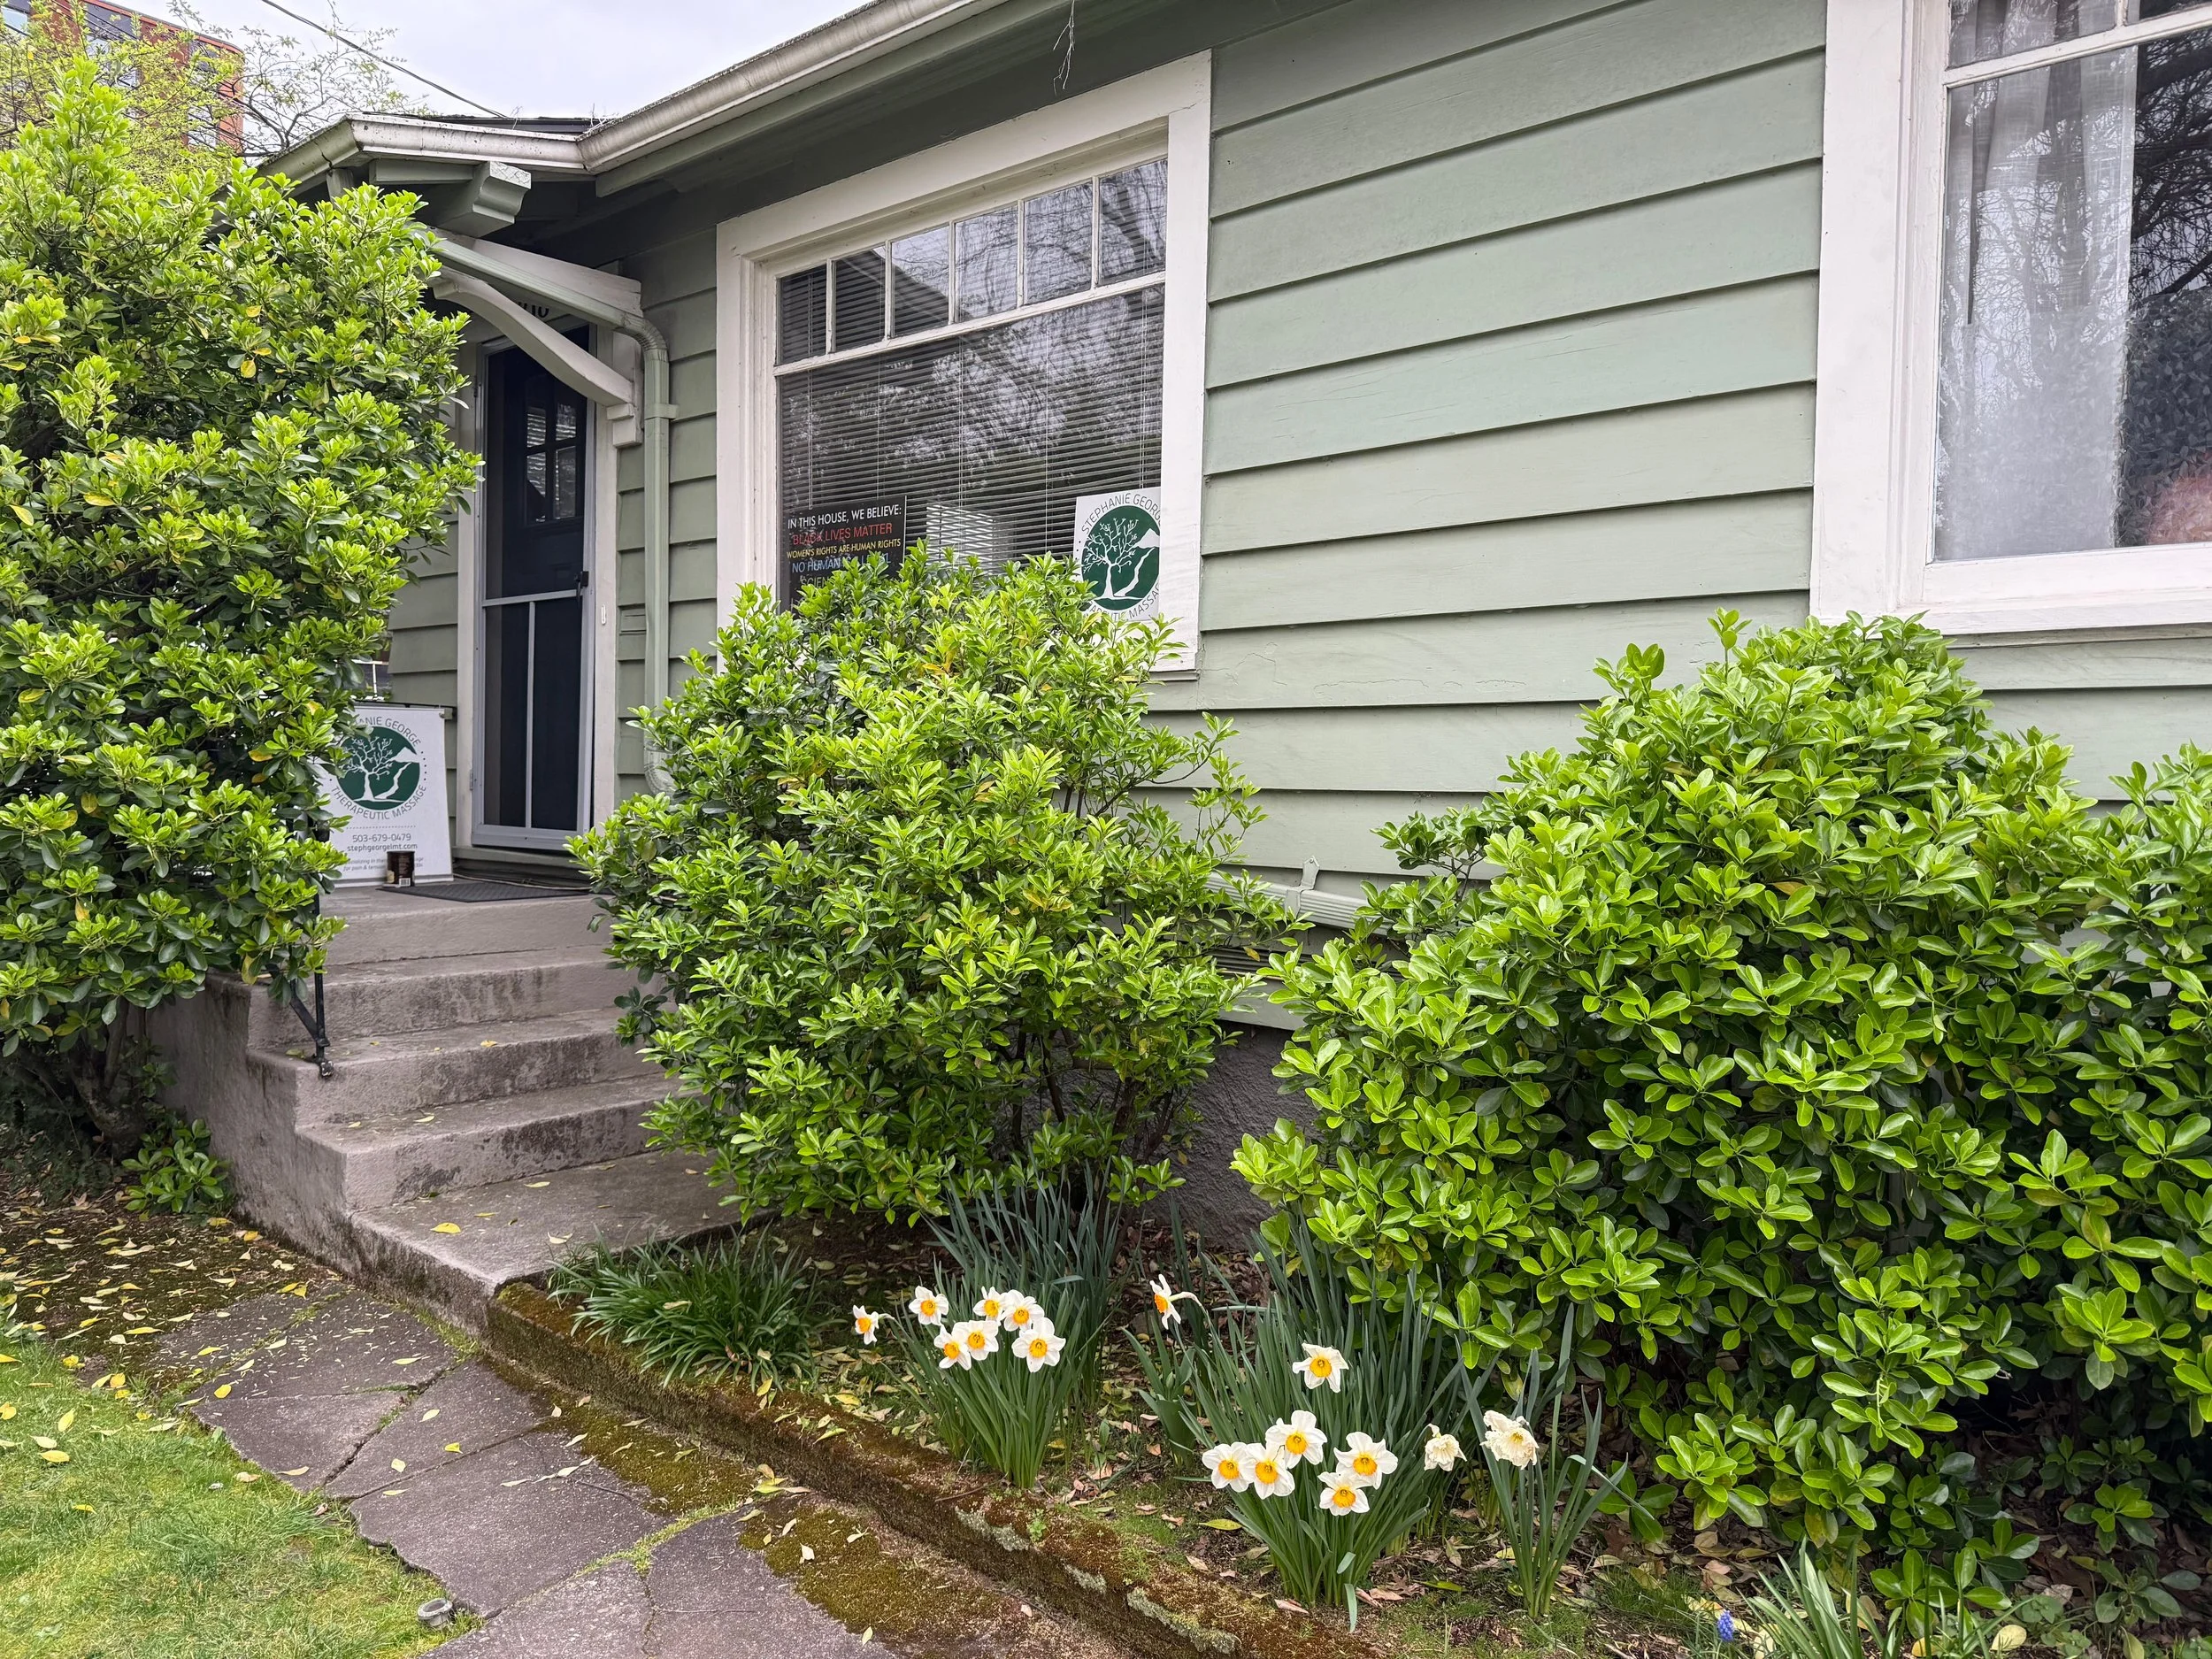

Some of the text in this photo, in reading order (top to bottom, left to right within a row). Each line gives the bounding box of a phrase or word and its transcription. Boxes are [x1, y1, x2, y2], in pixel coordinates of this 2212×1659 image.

[787, 504, 902, 529] IN THIS HOUSE, WE BELIEVE:
[1081, 493, 1131, 534] STEPHANIE
[793, 522, 893, 545] BLACK LIVES MATTER
[786, 549, 814, 559] WOMEN'S
[816, 545, 837, 556] RIGHTS
[851, 541, 876, 552] HUMAN
[878, 538, 902, 549] RIGHTS
[792, 561, 805, 573] NO
[807, 557, 841, 572] HUMAN
[1129, 583, 1159, 619] MASSA
[385, 718, 421, 747] GEORGE
[331, 784, 426, 819] THERAPEUTIC MASSAGE
[352, 833, 411, 842] 503-679-0479
